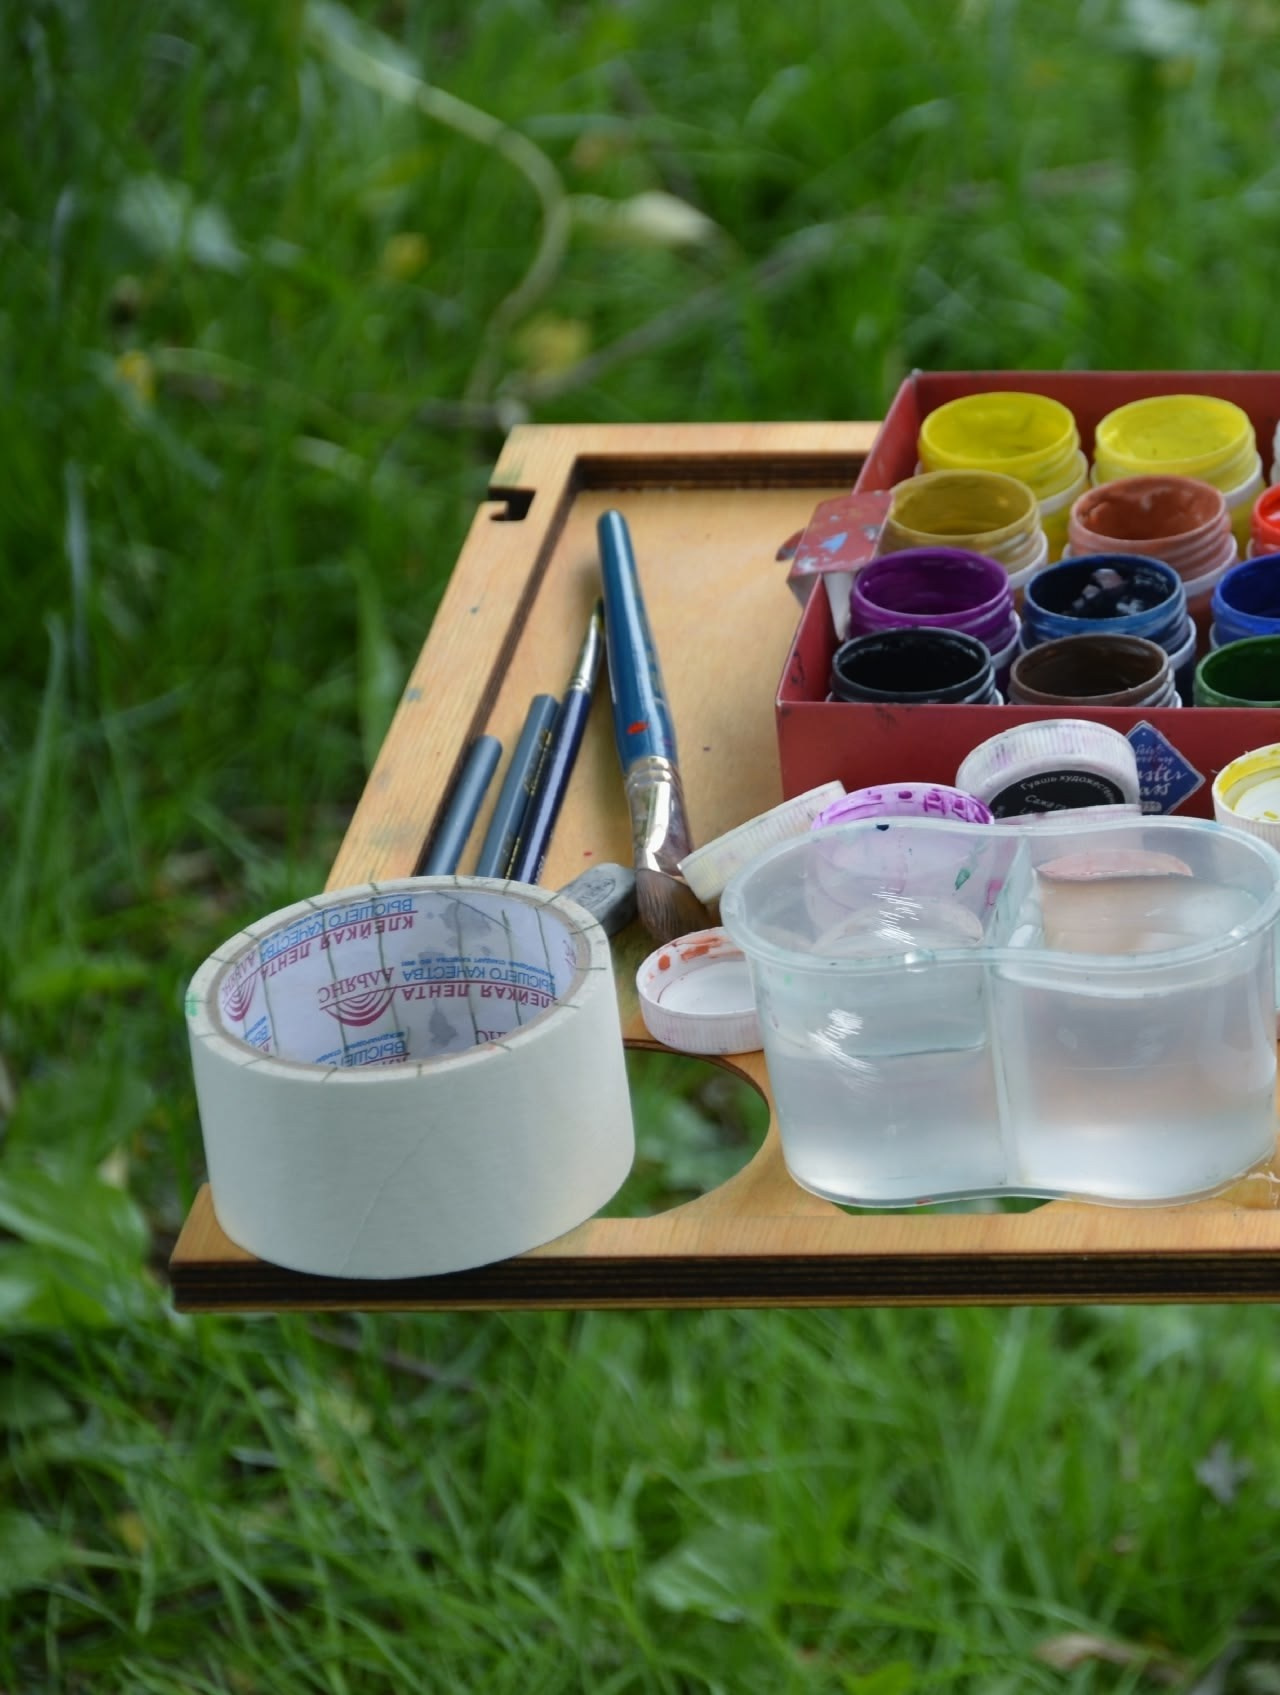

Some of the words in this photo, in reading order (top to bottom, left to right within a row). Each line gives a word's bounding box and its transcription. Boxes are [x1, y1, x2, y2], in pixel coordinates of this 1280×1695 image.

[1020, 775, 1056, 791] Гуашь
[328, 898, 412, 928] ВЫСШЕГО
[320, 915, 414, 951] КЛЕЙКАЯ
[260, 942, 311, 981] ЛЕНТА
[402, 965, 486, 983] КАЧЕСТВА
[317, 966, 395, 1004] АЛЬЯНС
[401, 983, 470, 1001] ЛЕНТА
[480, 984, 552, 1009] ЛЕЙКАЯ
[328, 1040, 406, 1066] ВЫСШЕ
